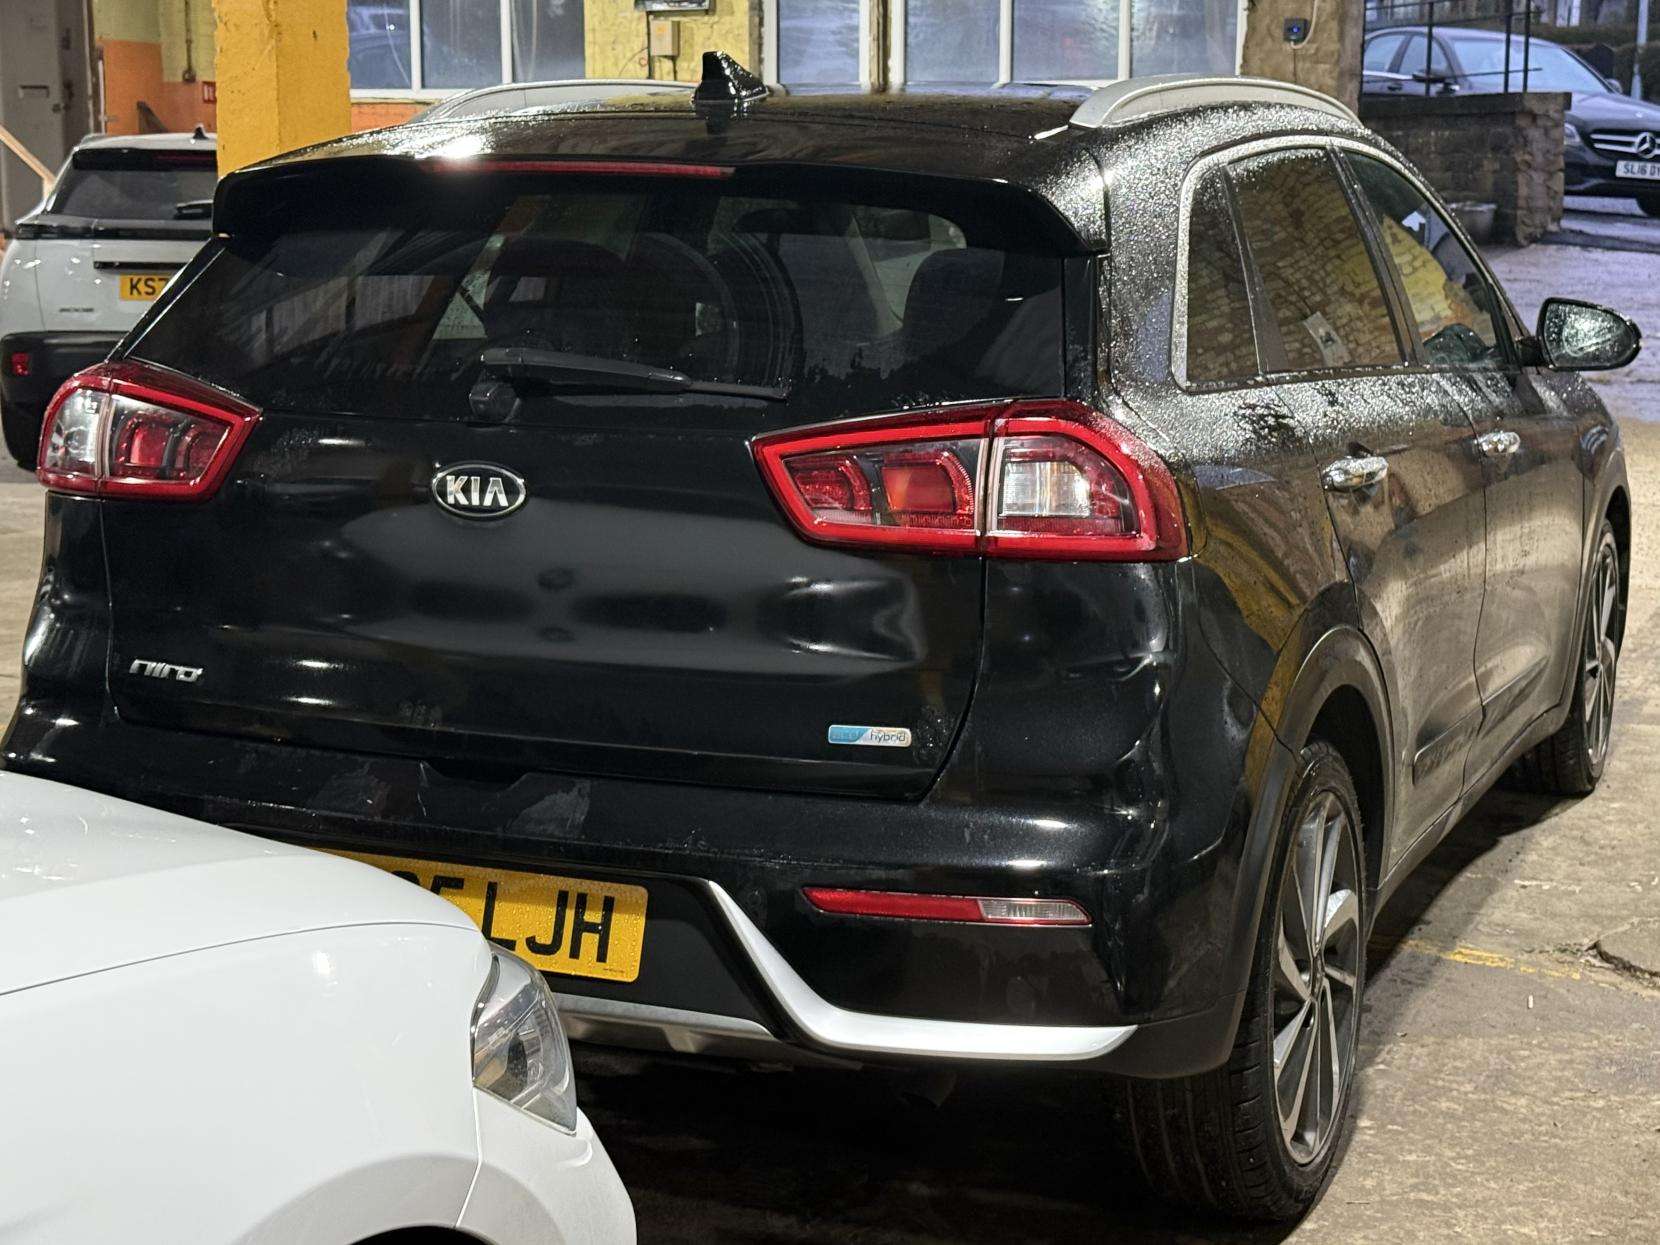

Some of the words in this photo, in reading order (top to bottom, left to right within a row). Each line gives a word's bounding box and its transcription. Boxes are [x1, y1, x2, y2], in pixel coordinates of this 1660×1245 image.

[446, 475, 509, 507] KIA
[128, 659, 204, 682] niro
[870, 728, 906, 744] hybrid
